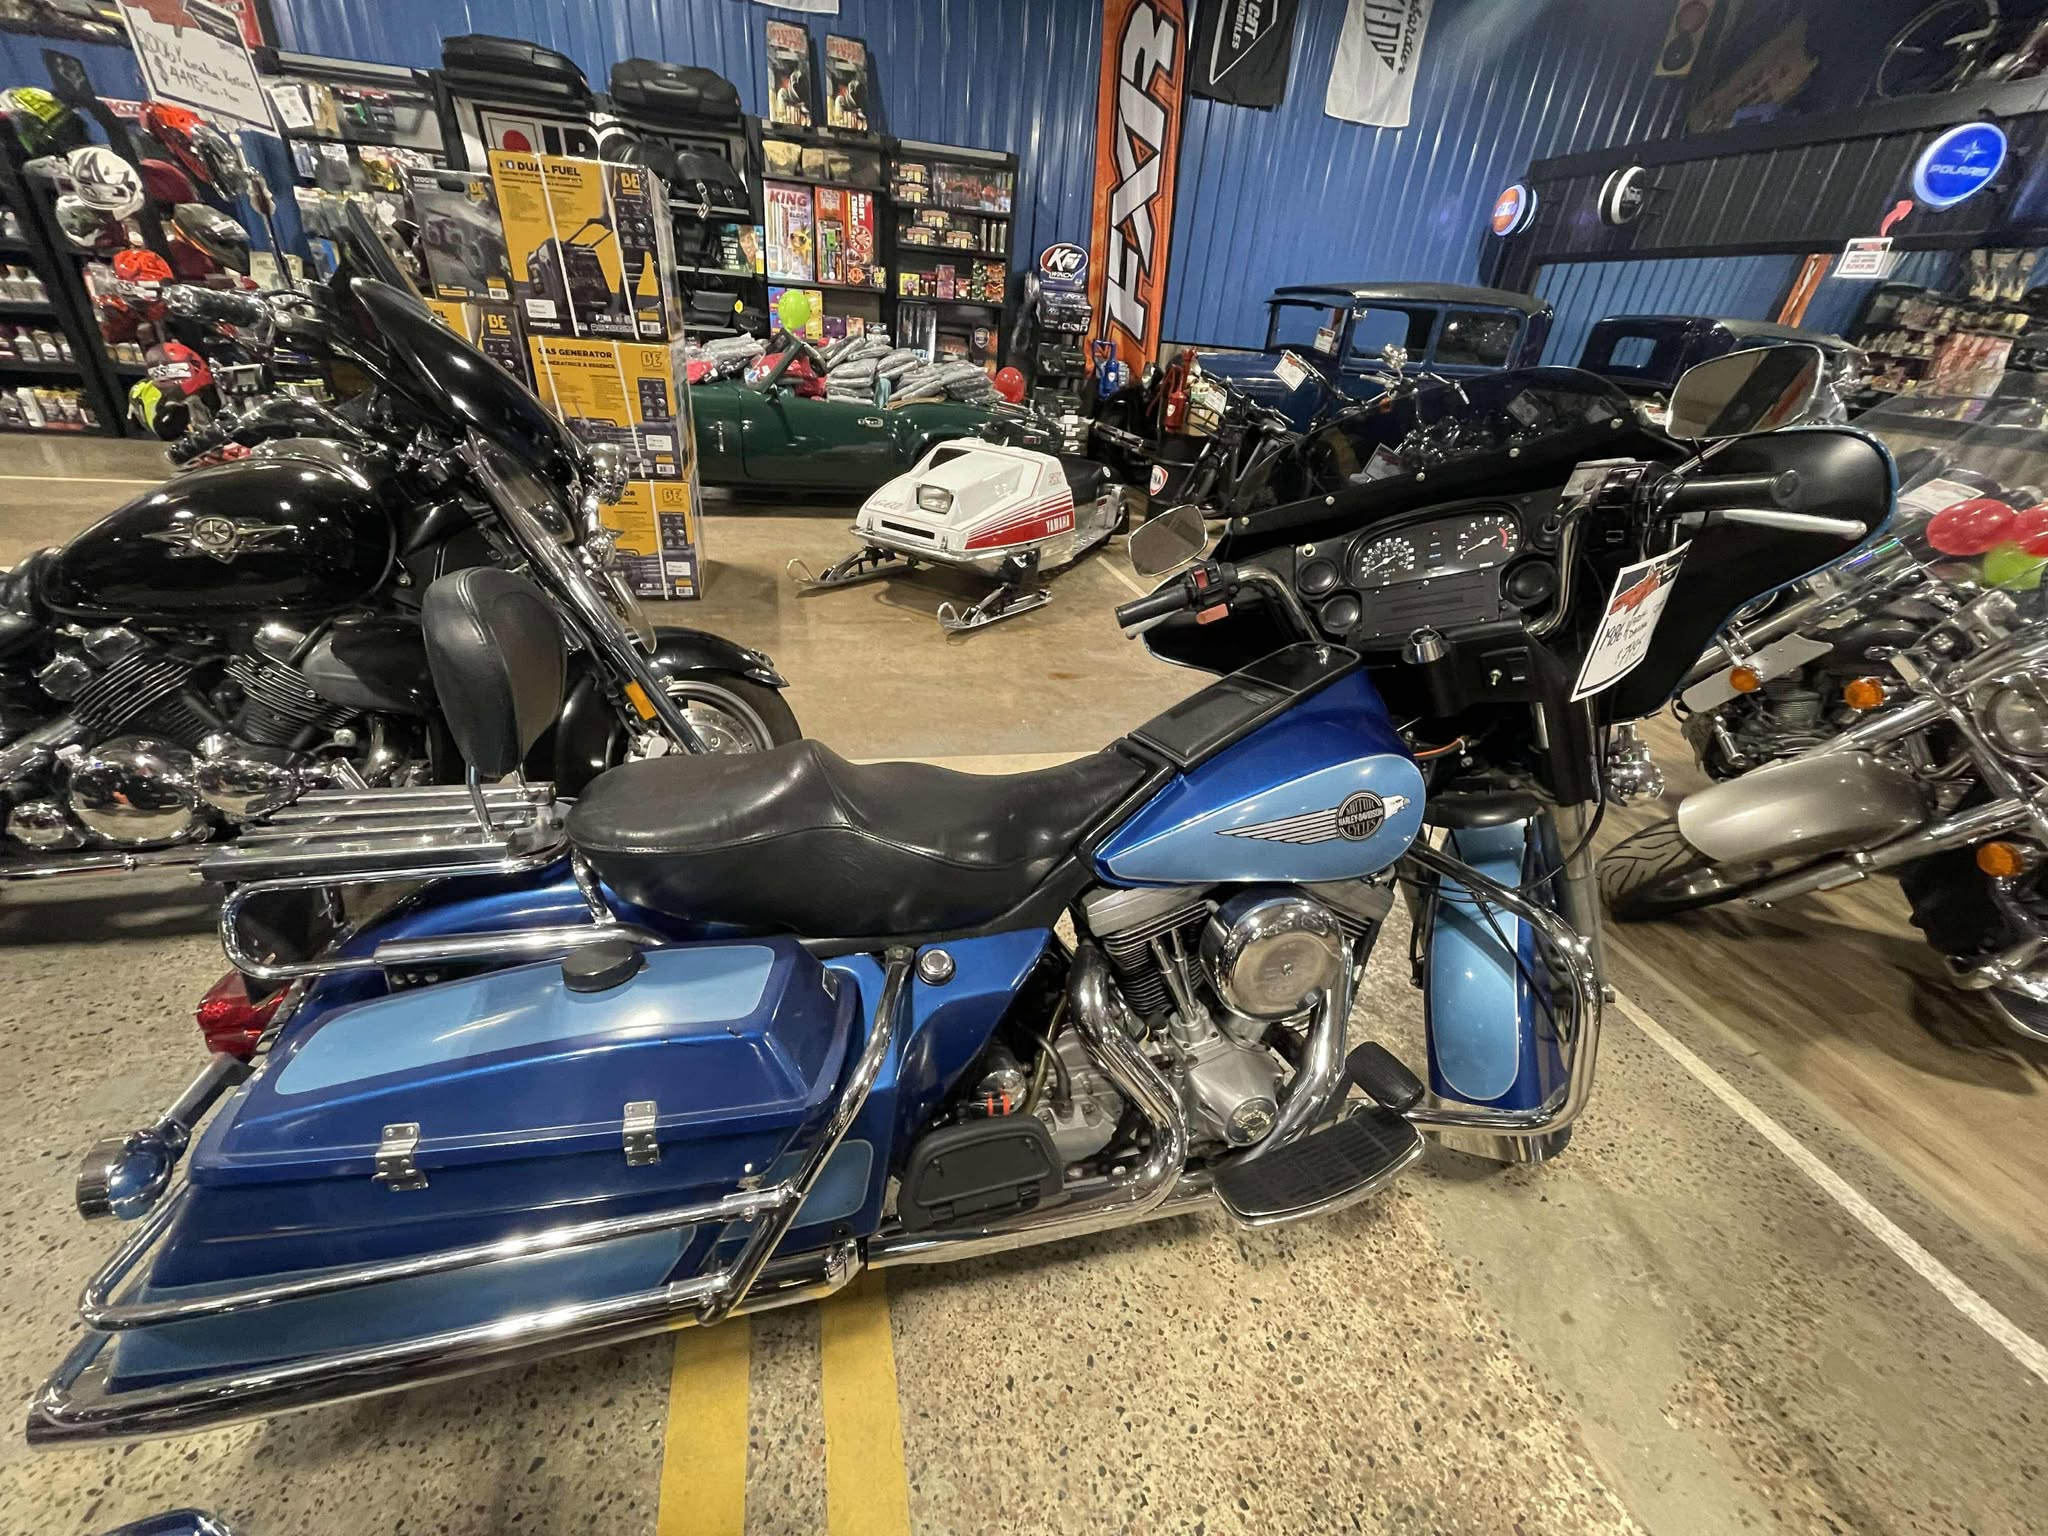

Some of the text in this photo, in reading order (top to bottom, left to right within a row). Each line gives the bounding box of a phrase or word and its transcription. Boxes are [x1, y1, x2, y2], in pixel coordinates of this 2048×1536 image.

[517, 161, 581, 177] DUAL FUEL
[1106, 3, 1176, 341] FXR
[1927, 163, 1991, 178] POLARIS
[620, 172, 641, 188] BE
[769, 190, 808, 207] KING
[487, 314, 508, 329] BE
[558, 349, 613, 359] GENERATOR
[640, 351, 663, 367] BE
[662, 488, 683, 504] BE
[1045, 514, 1070, 533] YAMAHA
